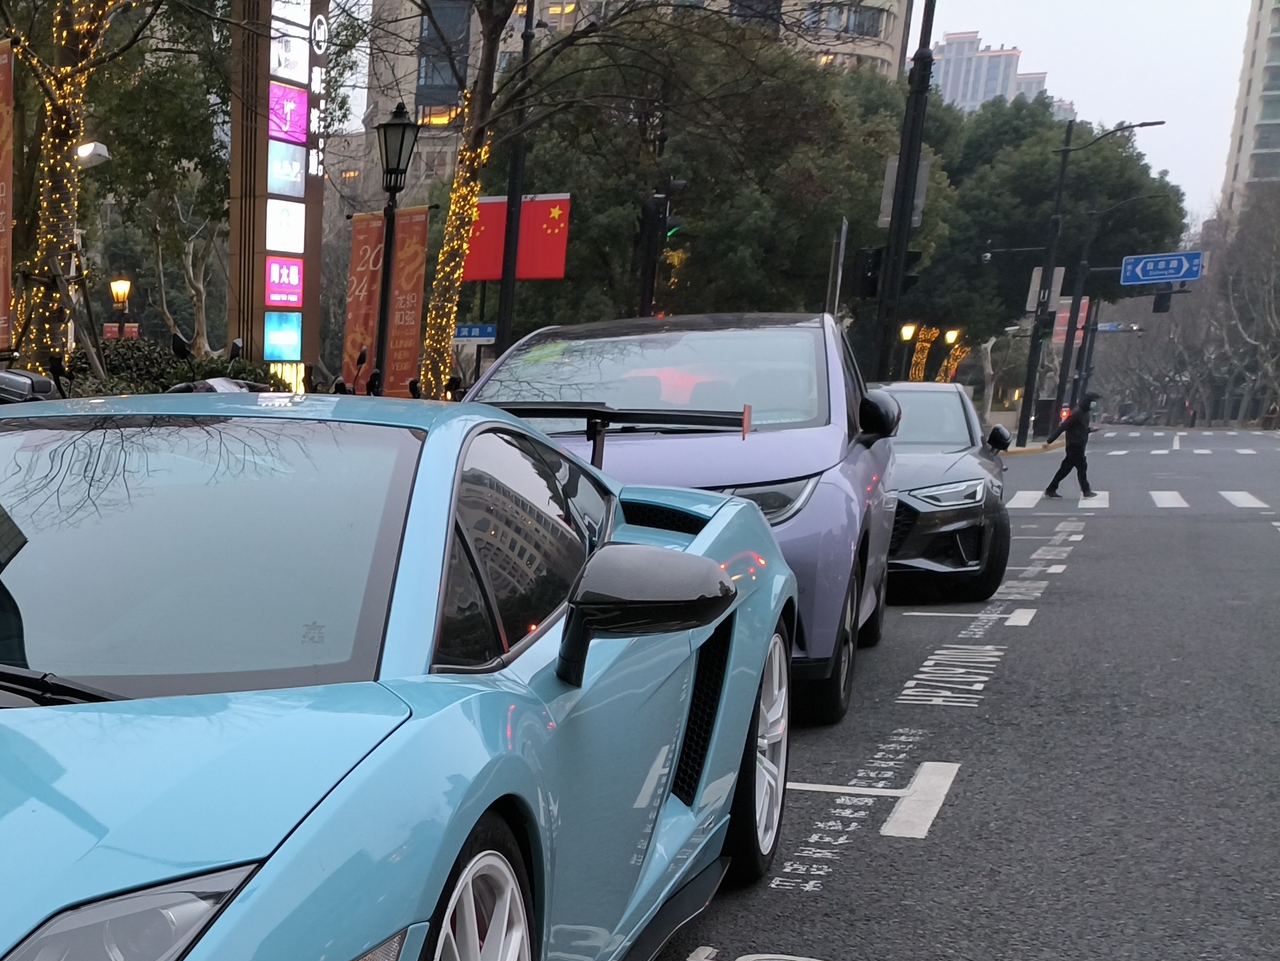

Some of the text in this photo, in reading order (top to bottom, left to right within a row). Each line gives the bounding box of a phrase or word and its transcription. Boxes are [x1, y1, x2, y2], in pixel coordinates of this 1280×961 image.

[356, 244, 384, 272] 20
[346, 276, 368, 302] 24
[390, 338, 416, 349] LUNAR
[393, 350, 410, 360] NEW
[391, 361, 411, 371] YEAR
[894, 643, 1008, 708] HPZ097004
